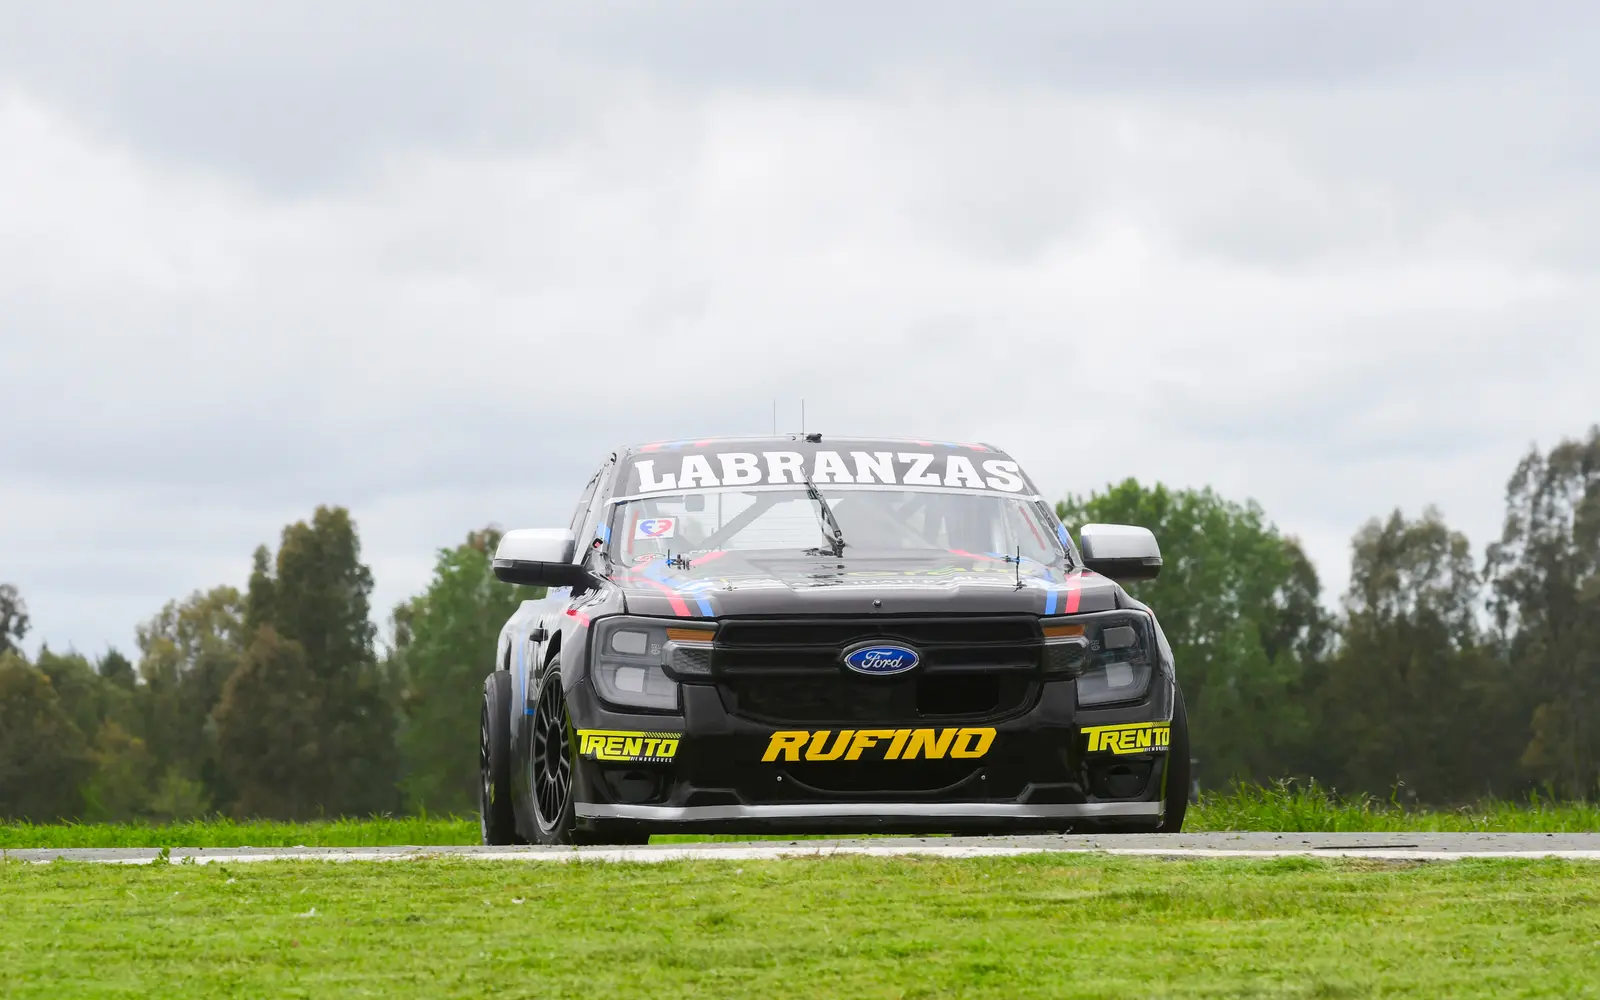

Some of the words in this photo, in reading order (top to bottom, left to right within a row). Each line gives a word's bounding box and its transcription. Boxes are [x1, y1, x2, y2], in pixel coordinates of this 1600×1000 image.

[634, 451, 1024, 493] LABRANZAS
[861, 650, 903, 669] Ford
[577, 729, 681, 761] TRENTO
[761, 727, 996, 763] RUFINO
[1080, 721, 1170, 755] TRENTO
